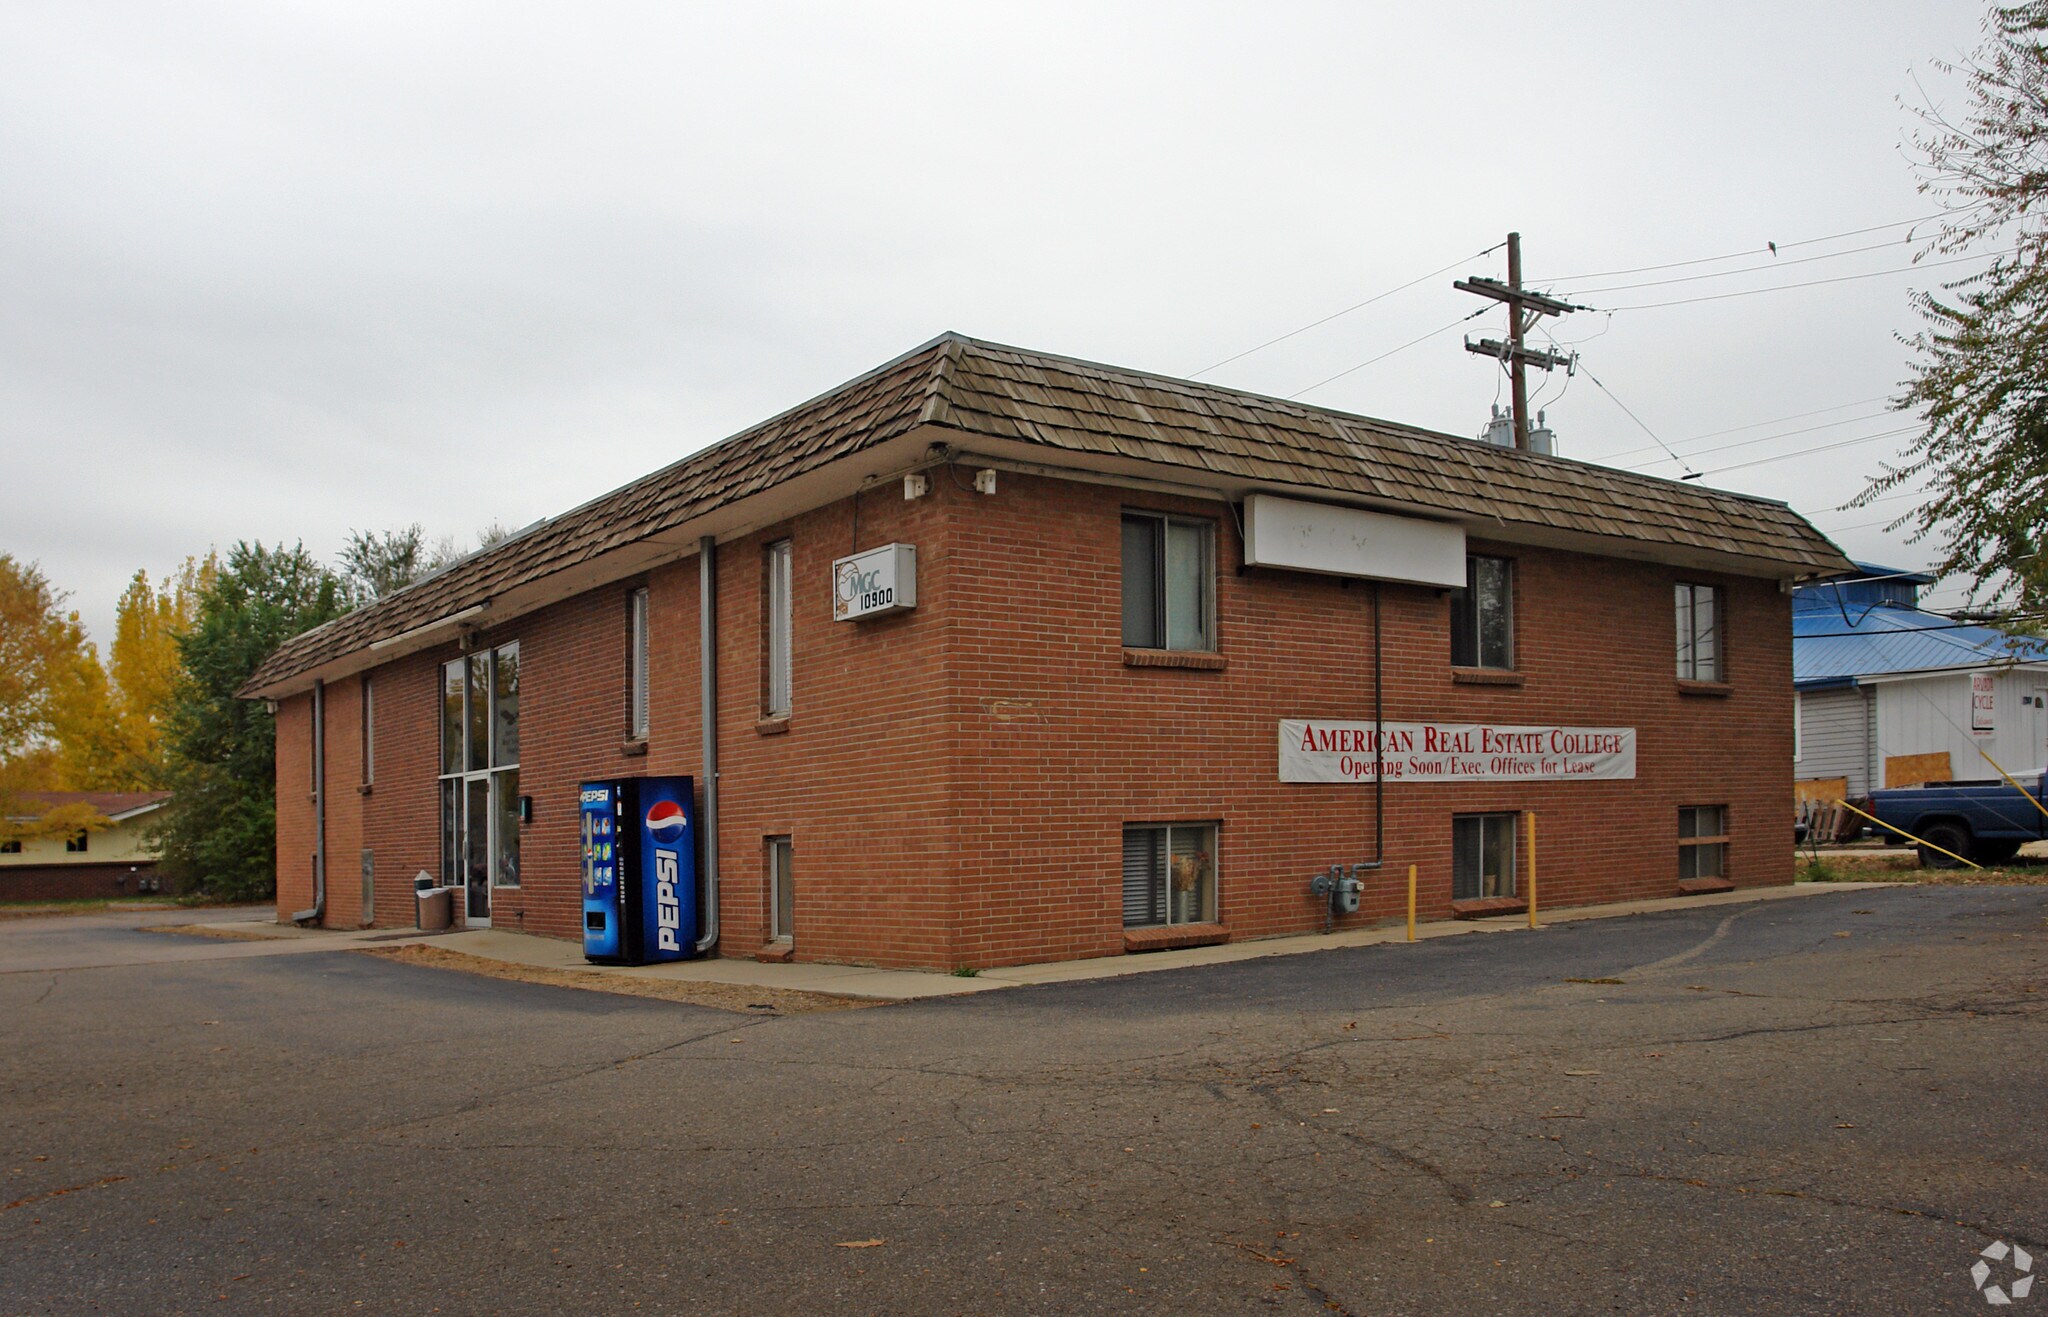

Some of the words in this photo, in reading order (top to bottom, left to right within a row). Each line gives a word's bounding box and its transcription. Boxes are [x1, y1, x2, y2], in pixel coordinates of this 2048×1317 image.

[850, 570, 881, 597] MGC
[861, 588, 892, 610] 10900
[1301, 724, 1414, 753] AMERICAN
[1424, 726, 1475, 753] REAL
[1481, 728, 1545, 754] ESTATE
[1550, 729, 1624, 754] COLLEGE
[1340, 756, 1403, 779] Opening
[1409, 756, 1485, 775] Soon/Exec.
[1491, 757, 1535, 775] Offices
[1541, 757, 1557, 774] for
[1563, 757, 1596, 774] Lease
[580, 789, 609, 802] PEPSI
[656, 849, 680, 952] PEPSI
